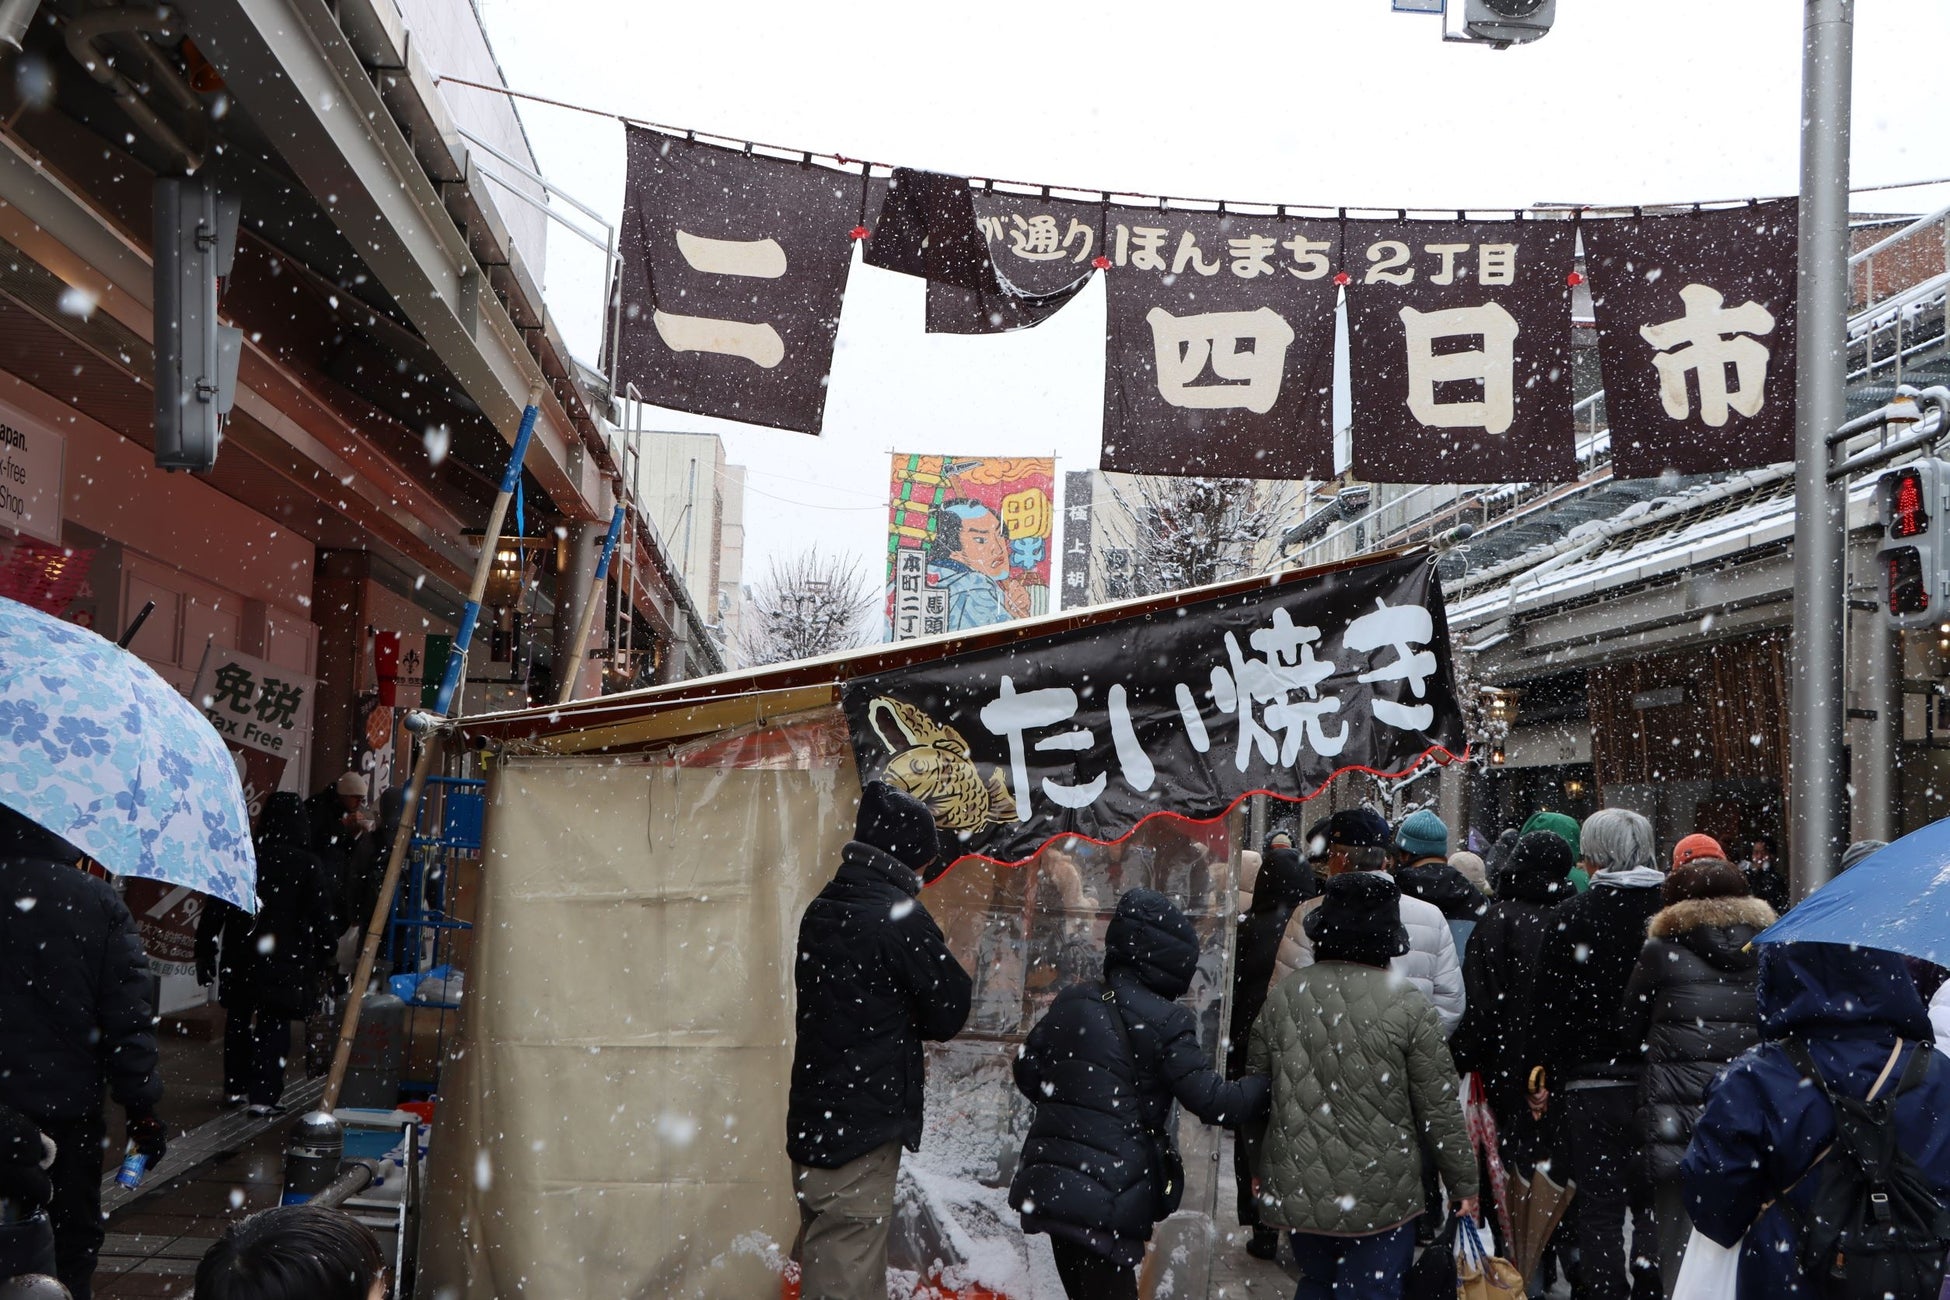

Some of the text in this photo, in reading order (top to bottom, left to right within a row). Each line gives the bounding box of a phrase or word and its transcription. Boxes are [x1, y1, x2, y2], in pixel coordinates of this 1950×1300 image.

[1115, 223, 1518, 286] ほんまち 2丁目
[0, 485, 24, 519] Shop
[900, 553, 922, 640] 本町二丁
[213, 662, 304, 730] 免税
[979, 597, 1439, 823] たい焼き
[205, 708, 284, 751] Tax Free
